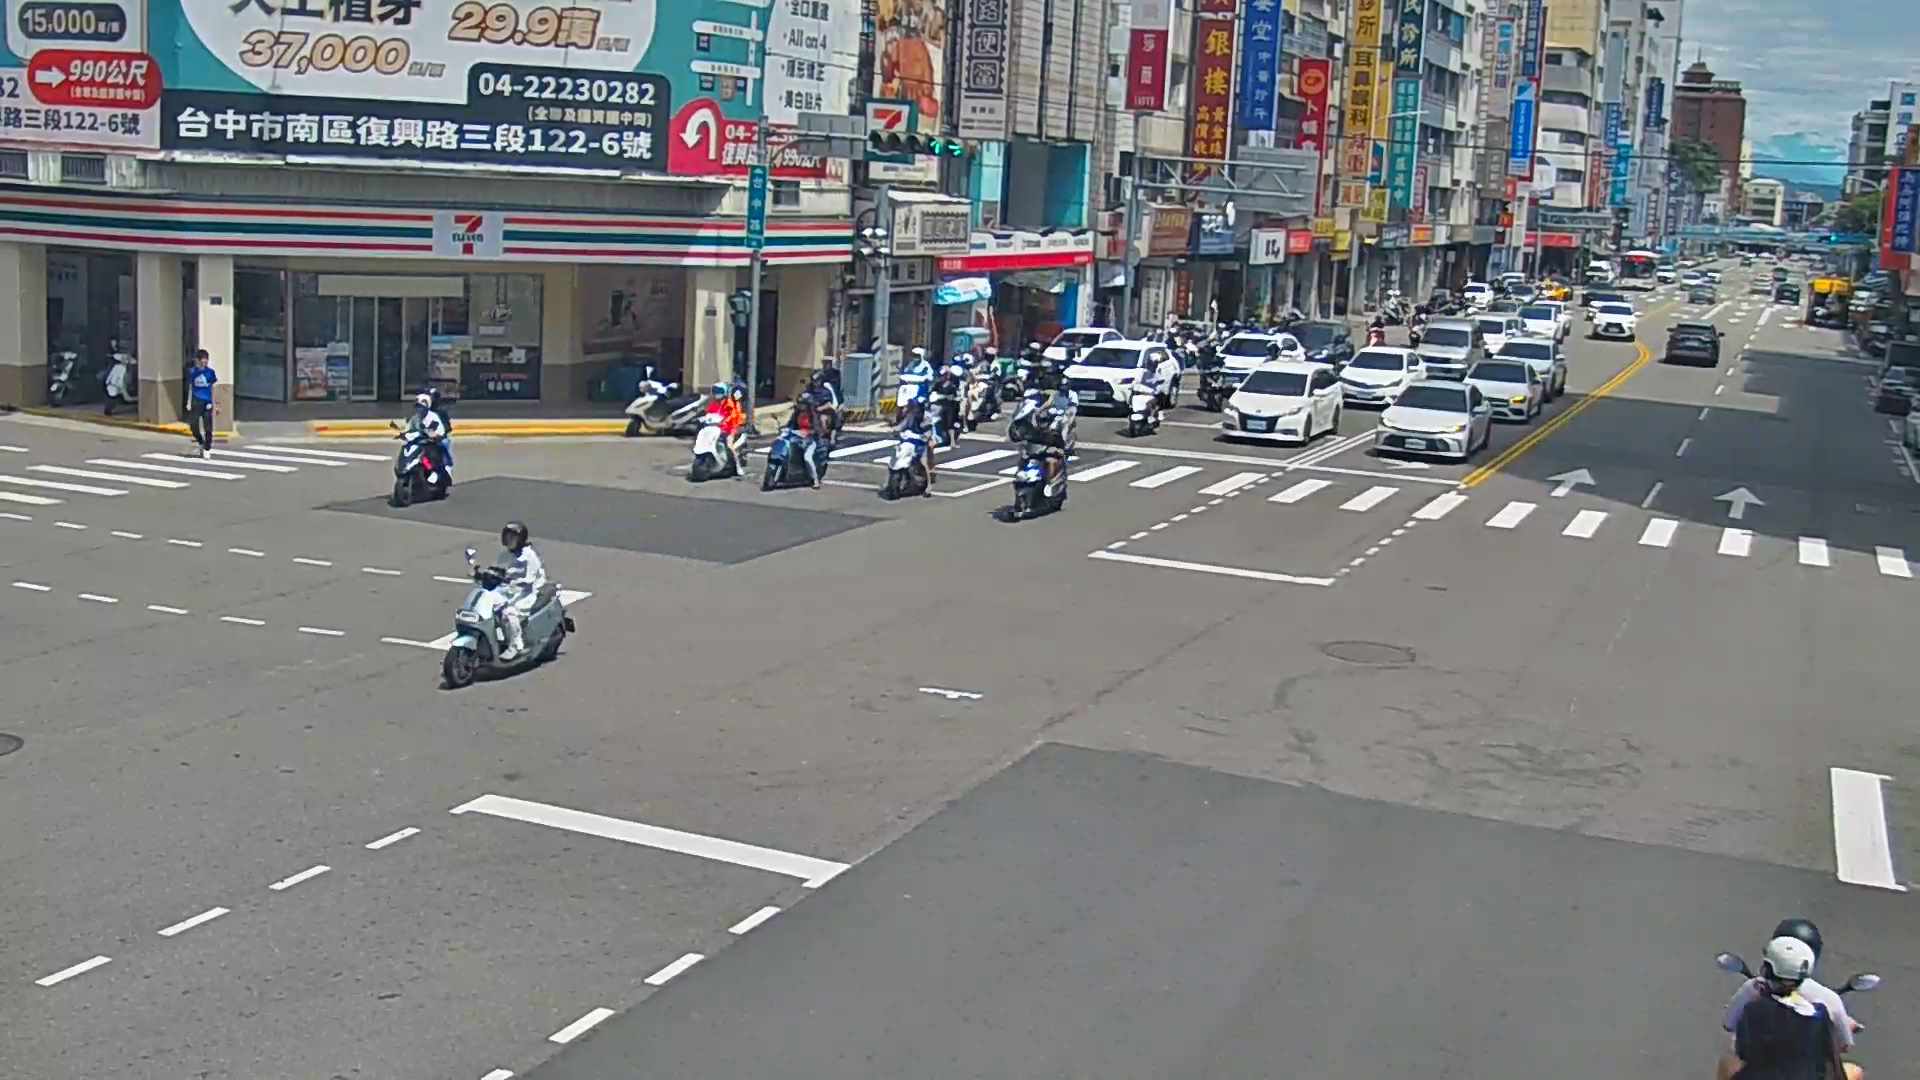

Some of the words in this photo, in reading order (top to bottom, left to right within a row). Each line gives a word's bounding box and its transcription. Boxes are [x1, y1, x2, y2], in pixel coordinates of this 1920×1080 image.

[23, 8, 96, 33] 15,000
[447, 1, 600, 49] 29.9萬
[239, 29, 410, 75] 37,000
[788, 28, 803, 47] All
[805, 36, 818, 49] on
[819, 34, 827, 50] 4
[68, 58, 149, 86] 990公尺
[478, 72, 656, 105] 04-22230282
[0, 106, 141, 135] 路三段122-6號
[176, 107, 653, 160] 台中市南區復興路三段122-6號
[454, 215, 483, 255] 7
